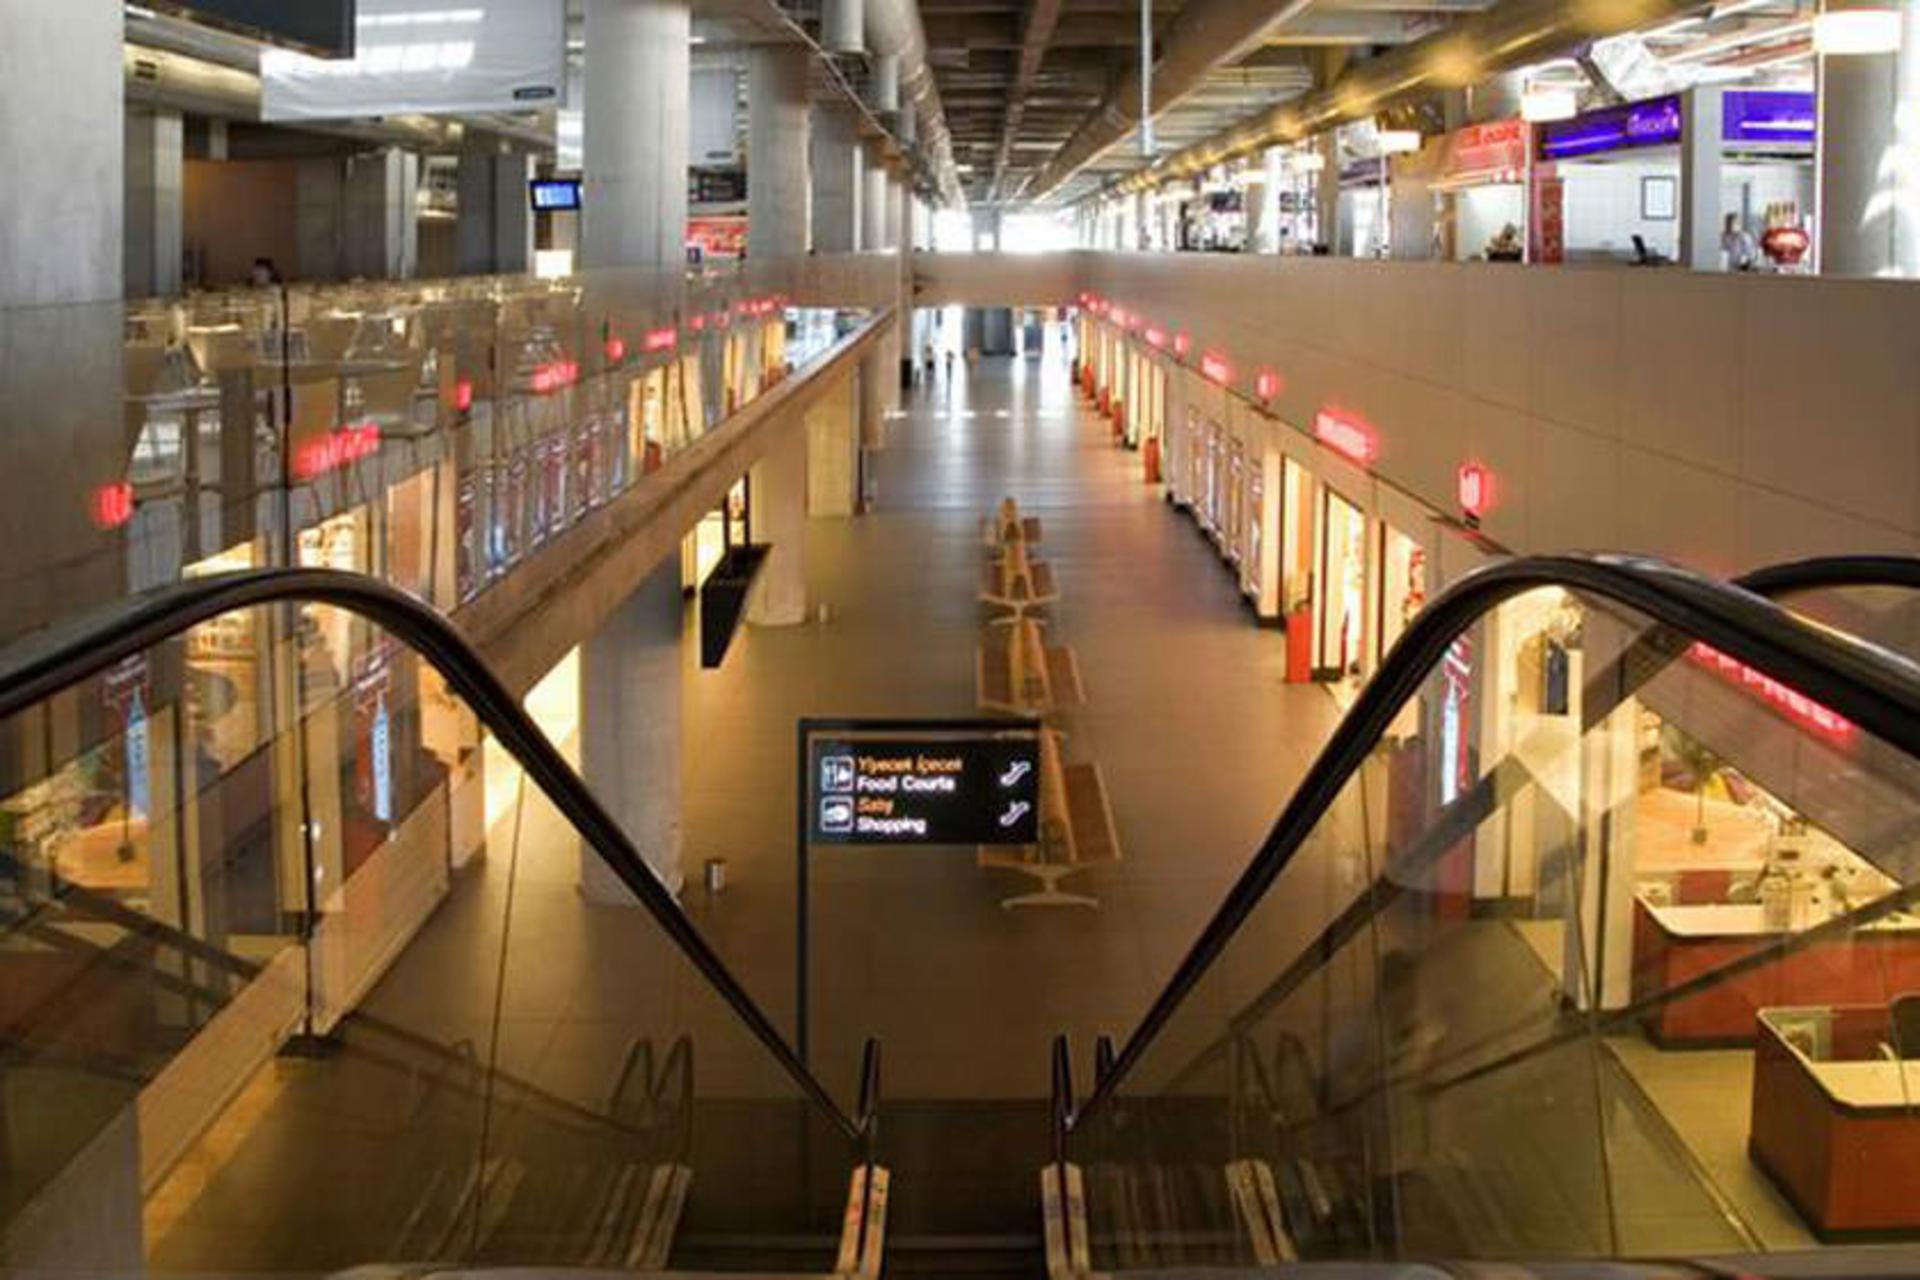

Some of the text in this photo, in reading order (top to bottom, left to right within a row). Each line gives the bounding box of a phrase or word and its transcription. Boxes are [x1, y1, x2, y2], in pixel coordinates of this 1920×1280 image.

[857, 775, 956, 792] Food Courts
[857, 815, 927, 834] Shopping
